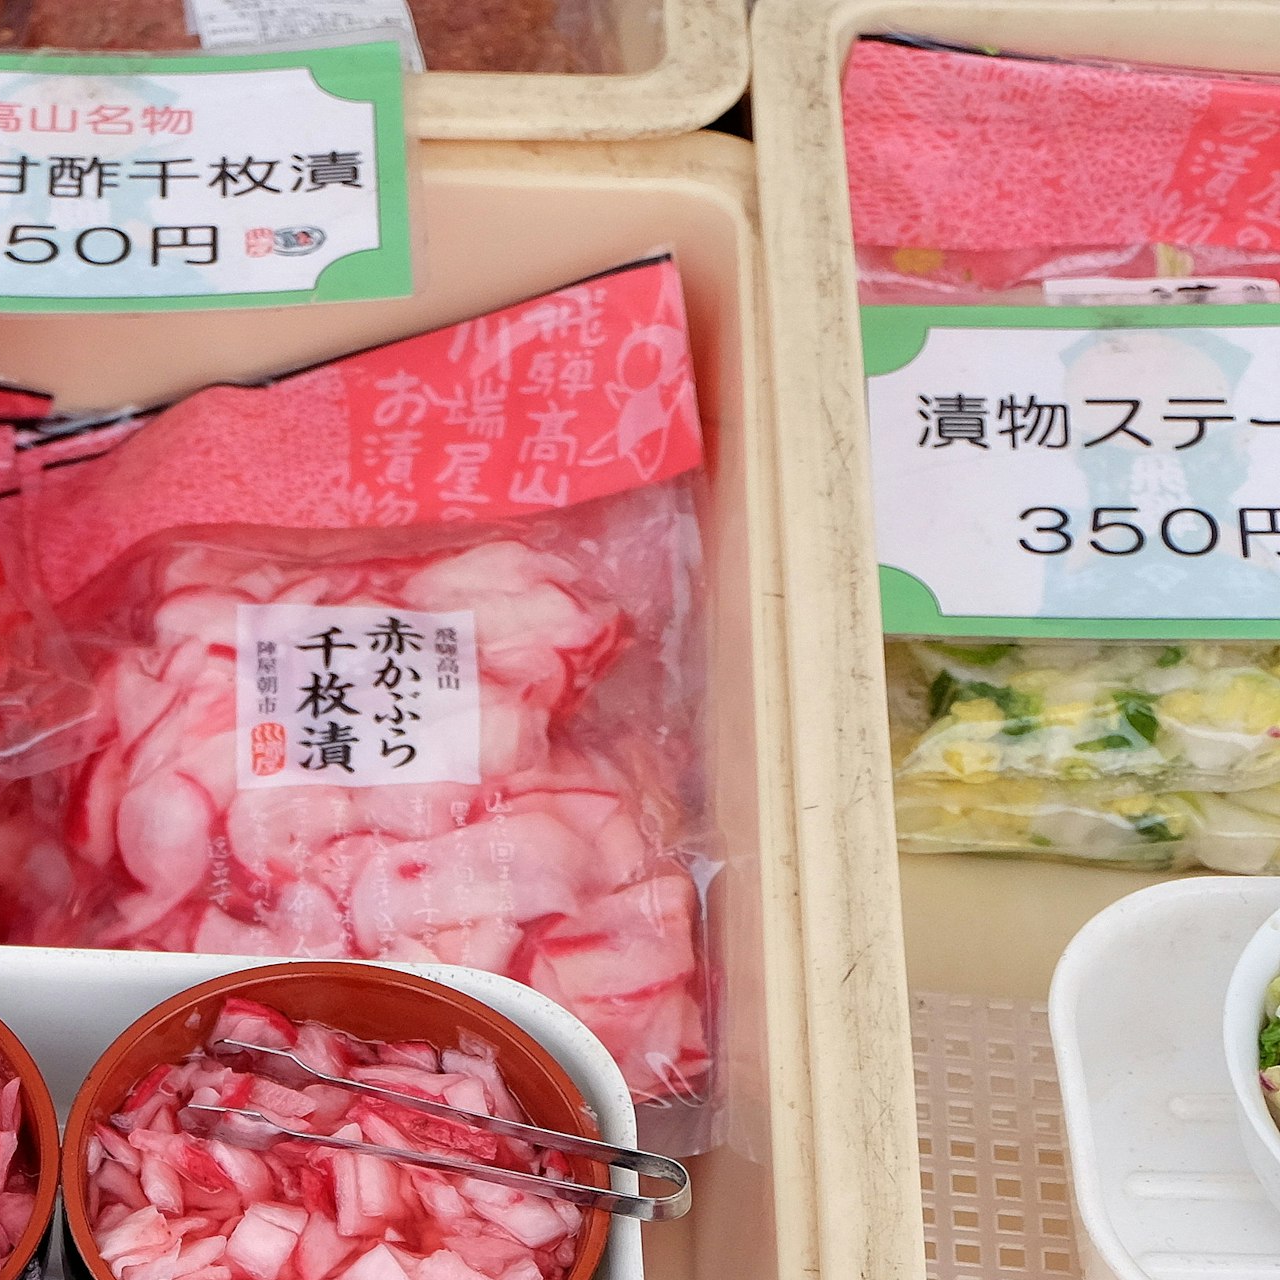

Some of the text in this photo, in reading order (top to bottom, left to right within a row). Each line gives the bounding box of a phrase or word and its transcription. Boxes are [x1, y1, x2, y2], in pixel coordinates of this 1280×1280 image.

[294, 626, 361, 773] 千枚漬
[366, 616, 424, 768] 赤かぶら
